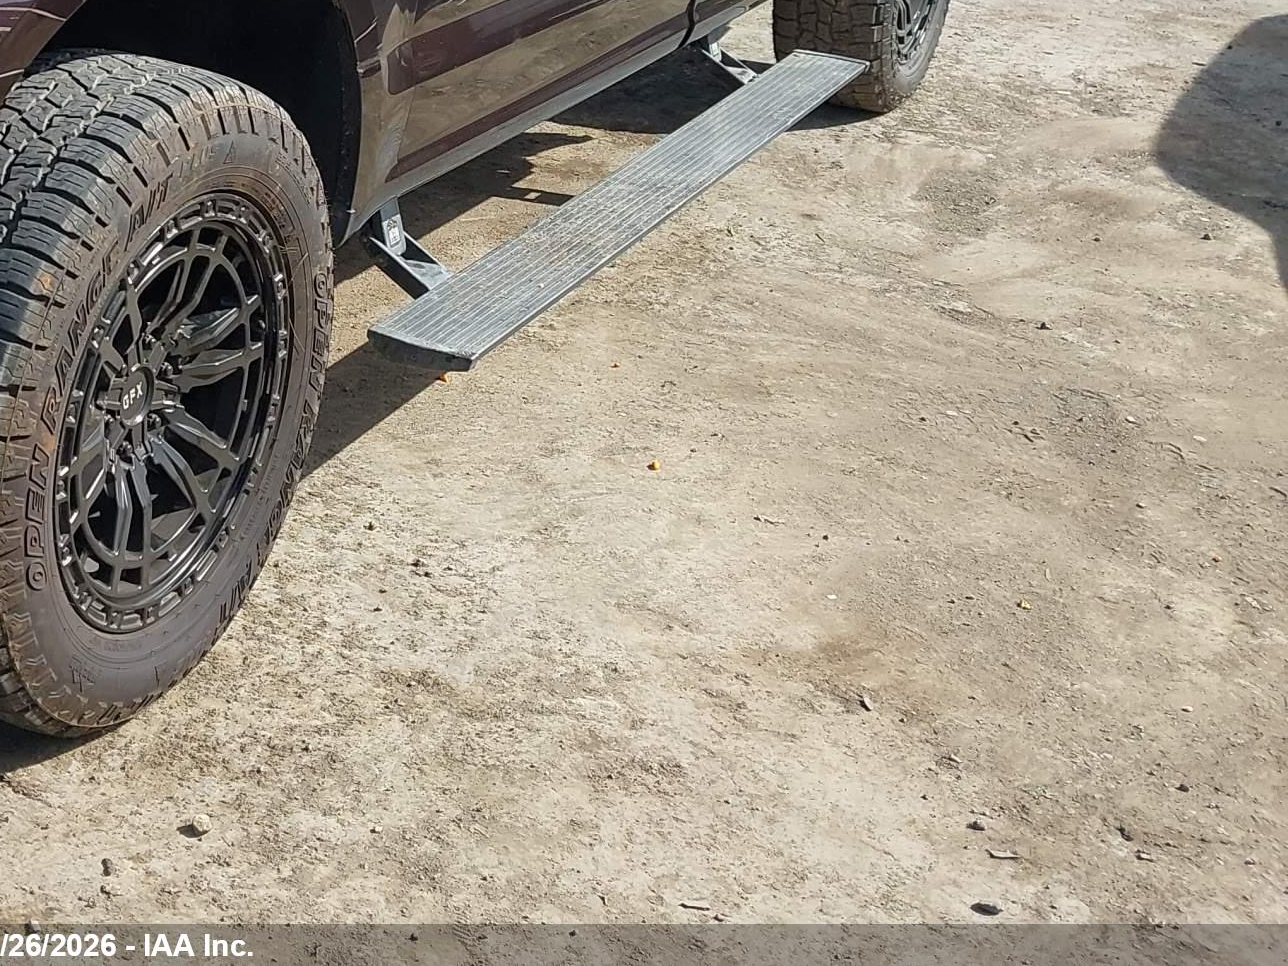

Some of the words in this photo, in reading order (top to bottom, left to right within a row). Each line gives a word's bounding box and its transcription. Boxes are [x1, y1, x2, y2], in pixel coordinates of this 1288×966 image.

[309, 272, 329, 392] OPEN
[122, 381, 144, 411] GFX
[25, 442, 51, 592] OPEN
